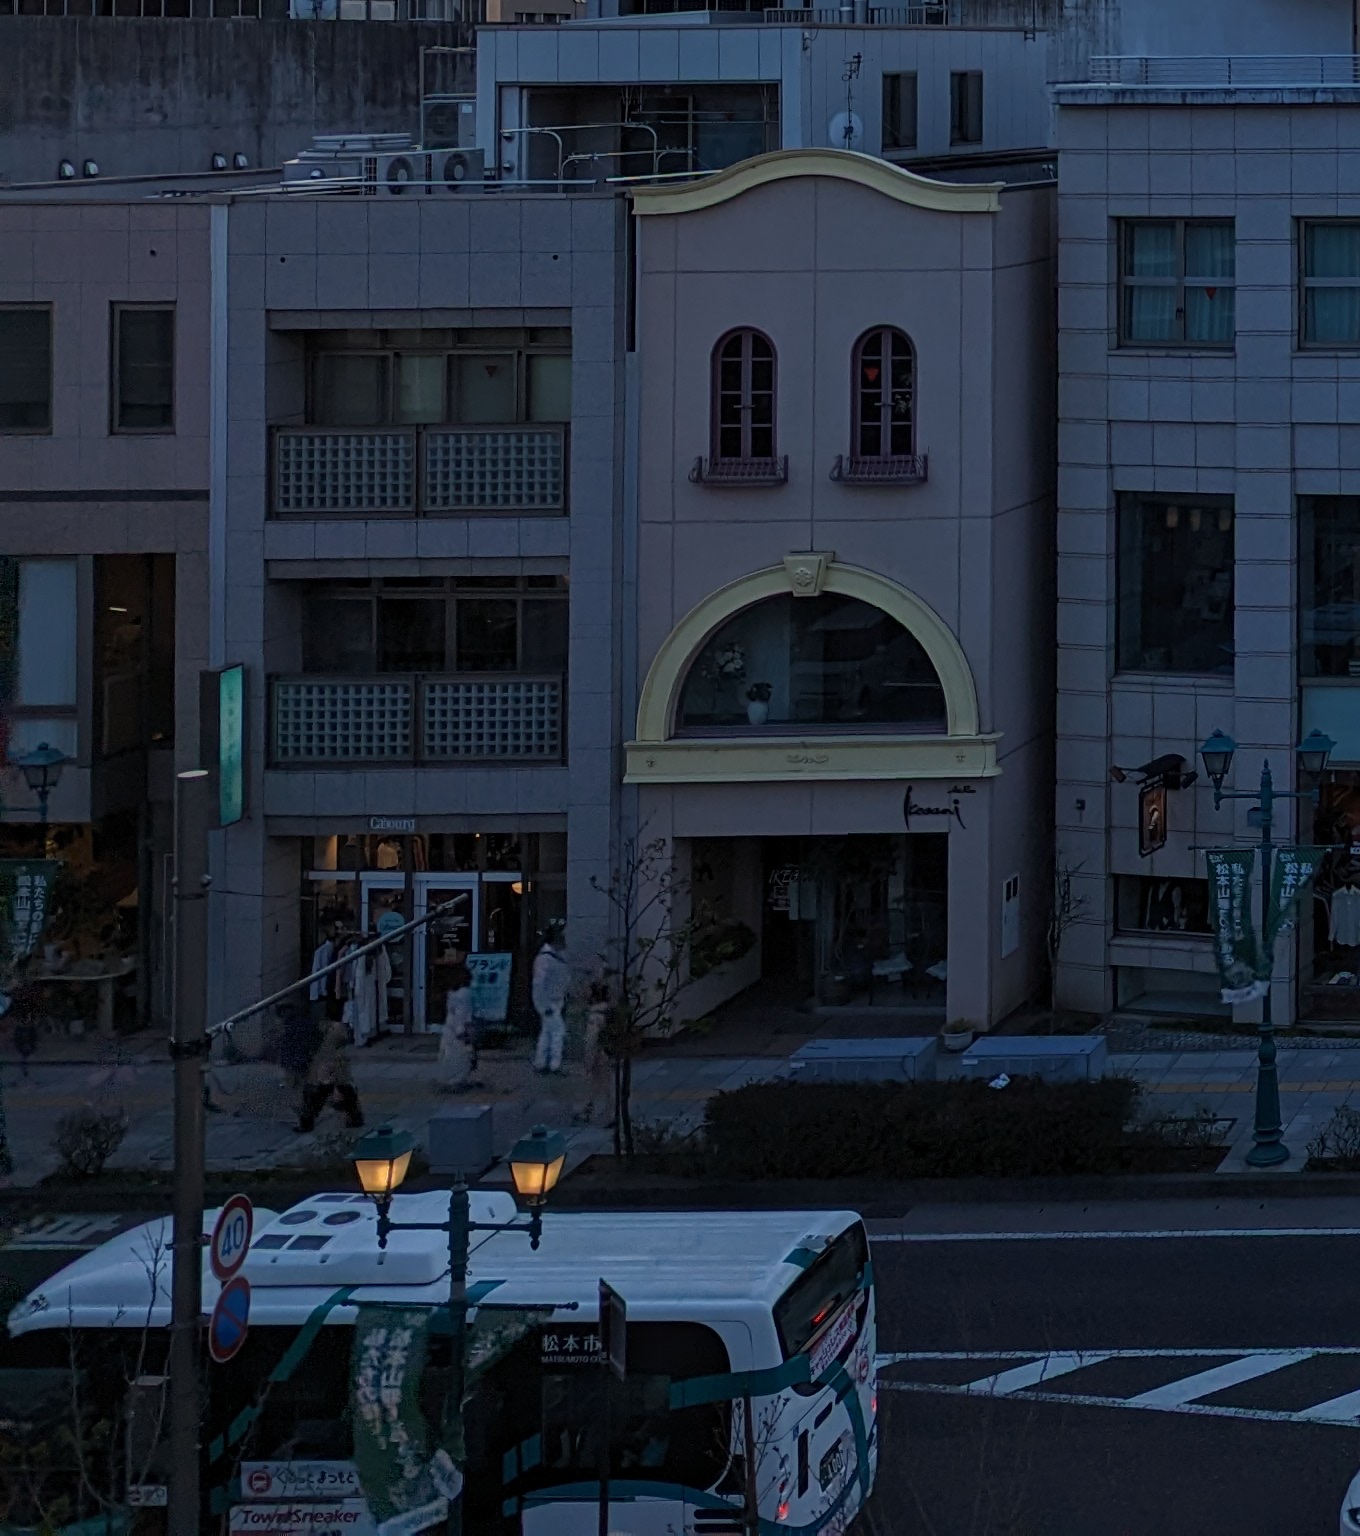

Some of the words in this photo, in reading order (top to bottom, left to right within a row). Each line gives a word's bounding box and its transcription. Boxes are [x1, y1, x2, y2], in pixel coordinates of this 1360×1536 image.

[222, 1215, 244, 1257] 40
[542, 1333, 602, 1353] 松本市
[290, 1509, 361, 1524] Sneaker
